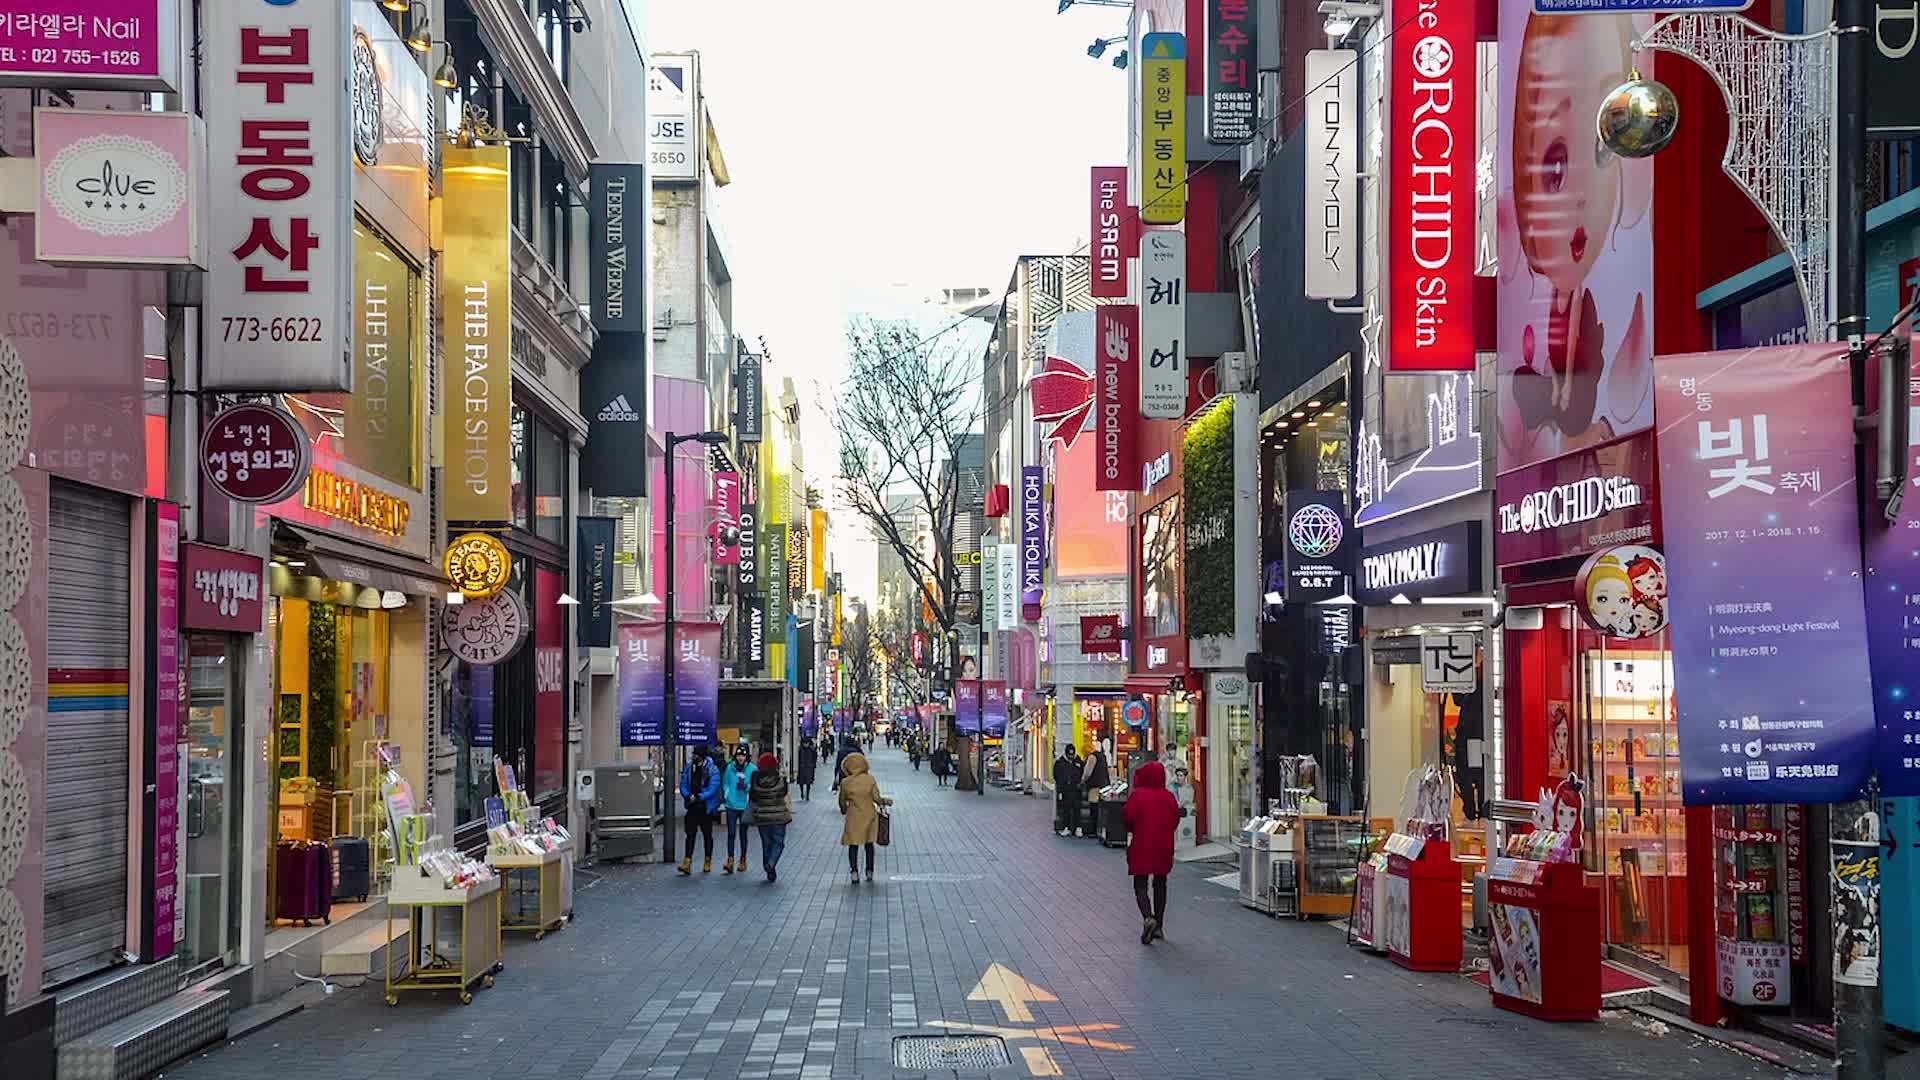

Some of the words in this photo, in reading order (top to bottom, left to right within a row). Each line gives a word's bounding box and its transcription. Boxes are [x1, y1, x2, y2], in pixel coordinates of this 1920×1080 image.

[93, 16, 140, 39] Nail
[62, 49, 140, 66] 755-1526
[1156, 67, 1171, 104] 중앙
[231, 26, 320, 293] 부동산
[1154, 110, 1174, 190] 부동산
[1324, 75, 1340, 272] TONYMOLY
[606, 177, 625, 244] TEENIE
[1100, 180, 1117, 210] the
[464, 281, 488, 337] THE
[606, 244, 627, 319] WEENIE
[222, 317, 323, 343] 773-6622
[1147, 277, 1180, 371] 헤어
[1415, 276, 1447, 348] Skin
[464, 343, 488, 413] FACE
[1105, 363, 1119, 400] new
[1680, 377, 1713, 411] 명동
[597, 409, 640, 422] adidas
[1105, 404, 1121, 479] balance
[464, 418, 488, 495] SHOP
[1698, 414, 1776, 499] 빛
[1779, 470, 1823, 493] 축제
[1025, 475, 1040, 532] HOLIKA
[1499, 503, 1521, 534] The
[1520, 477, 1605, 533] ORCHID
[1604, 476, 1642, 512] Skin
[739, 513, 754, 584] GUESS
[770, 533, 780, 578] NATURE
[1024, 537, 1040, 593] HOLIKA
[770, 581, 780, 634] REPUBLIC
[984, 562, 996, 623] MISSHA
[750, 607, 763, 661] ARITAUM
[537, 652, 562, 693] SALE
